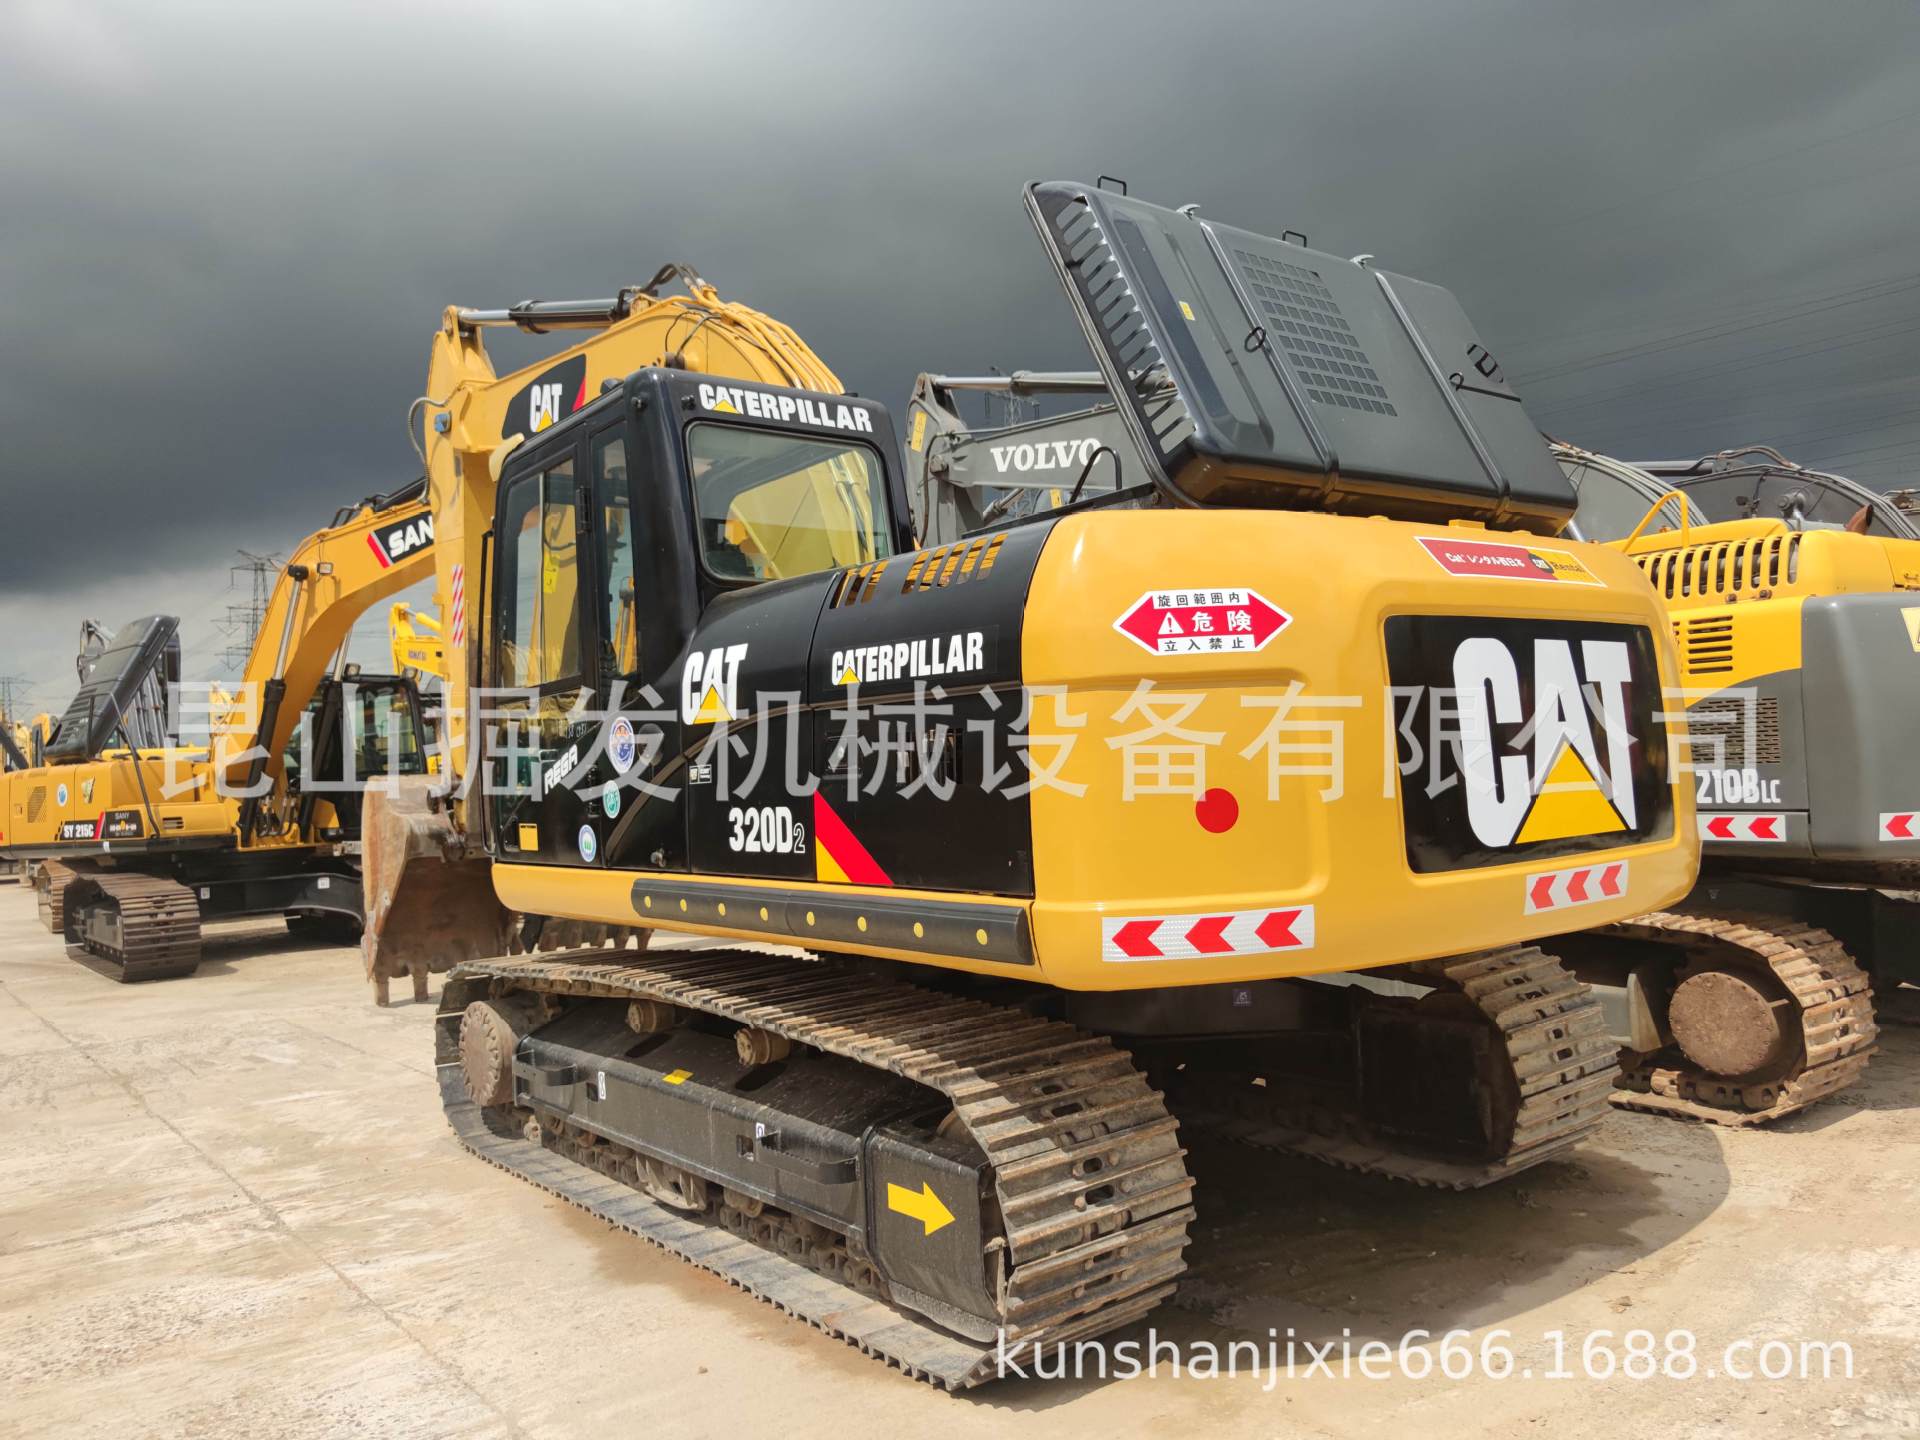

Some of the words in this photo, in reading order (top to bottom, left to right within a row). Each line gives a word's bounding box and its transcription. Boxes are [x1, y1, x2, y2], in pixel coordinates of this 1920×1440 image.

[529, 383, 563, 433] CAT
[698, 383, 873, 433] CATERPILLAR
[990, 437, 1102, 473] VOLVO
[388, 515, 434, 558] SAN
[1157, 592, 1241, 607] 旋回範囲内
[1191, 610, 1253, 633] 危険
[831, 631, 985, 687] CATERPILLAR
[1164, 637, 1246, 653] 立入禁止
[681, 643, 748, 726] CAT
[1451, 636, 1638, 848] CAT
[544, 743, 578, 795] REGA
[728, 806, 806, 854] 320D2
